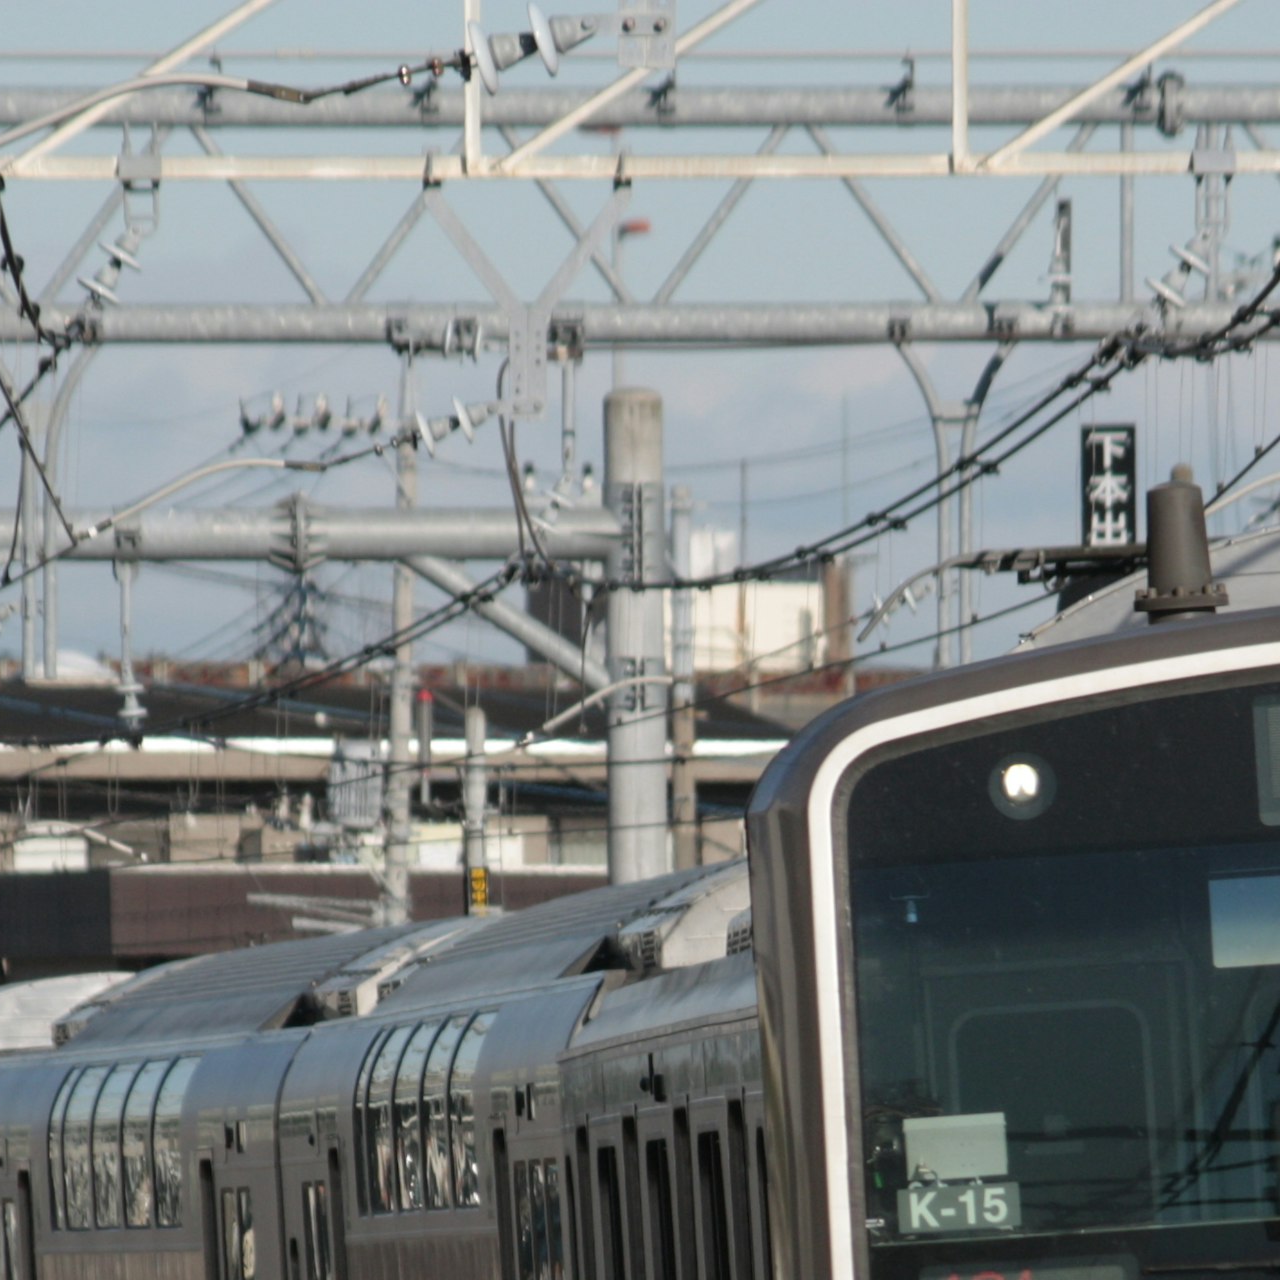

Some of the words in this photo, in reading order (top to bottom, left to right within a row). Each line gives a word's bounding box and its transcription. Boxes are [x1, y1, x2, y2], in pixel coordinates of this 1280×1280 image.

[1086, 431, 1130, 547] 下本出
[909, 1187, 1008, 1229] K-15
